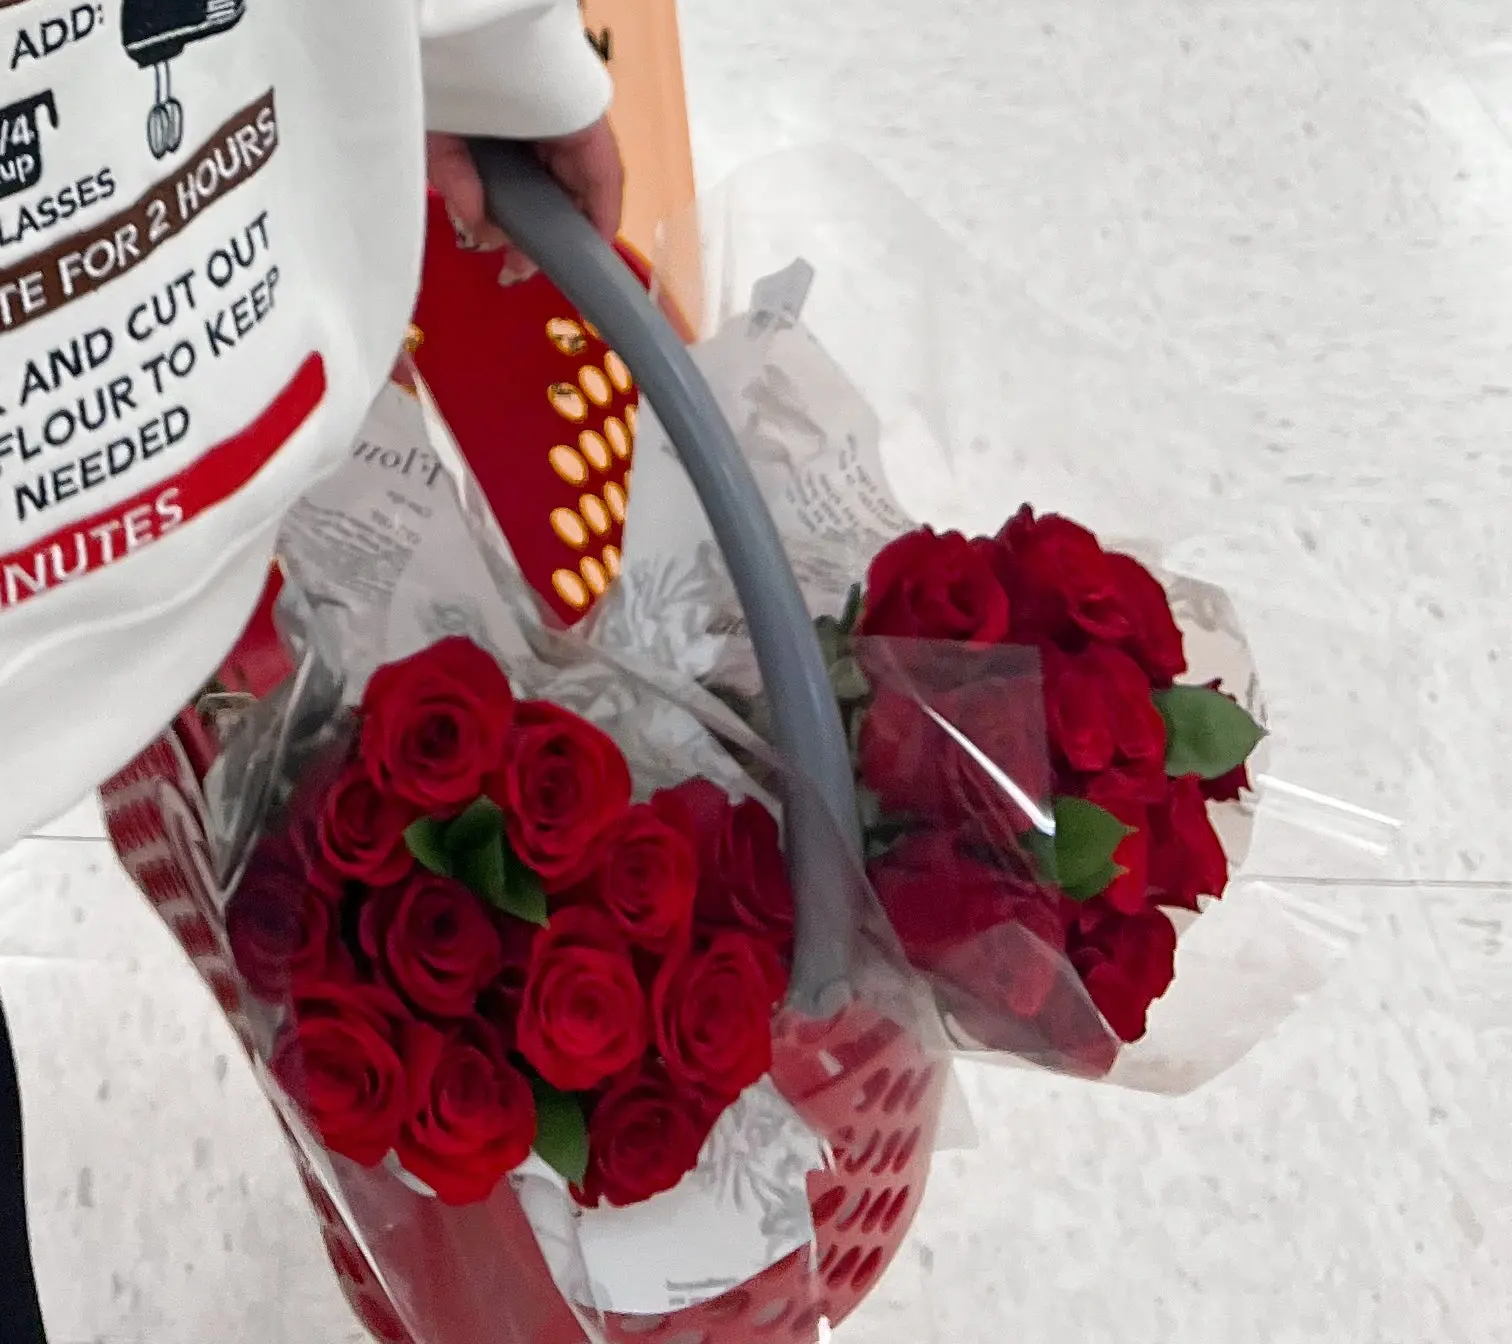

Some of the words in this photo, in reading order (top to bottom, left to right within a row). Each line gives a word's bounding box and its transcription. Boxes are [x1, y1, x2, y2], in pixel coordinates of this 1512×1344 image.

[10, 2, 105, 70] ADD:
[60, 229, 140, 296] FOR
[145, 202, 171, 238] 2
[178, 105, 279, 220] HOURS
[19, 327, 112, 405] AND
[125, 269, 199, 342] CUT
[206, 211, 272, 288] OUT
[143, 339, 196, 394] TO
[205, 265, 281, 356] KEEP
[14, 405, 191, 521] NEEDED
